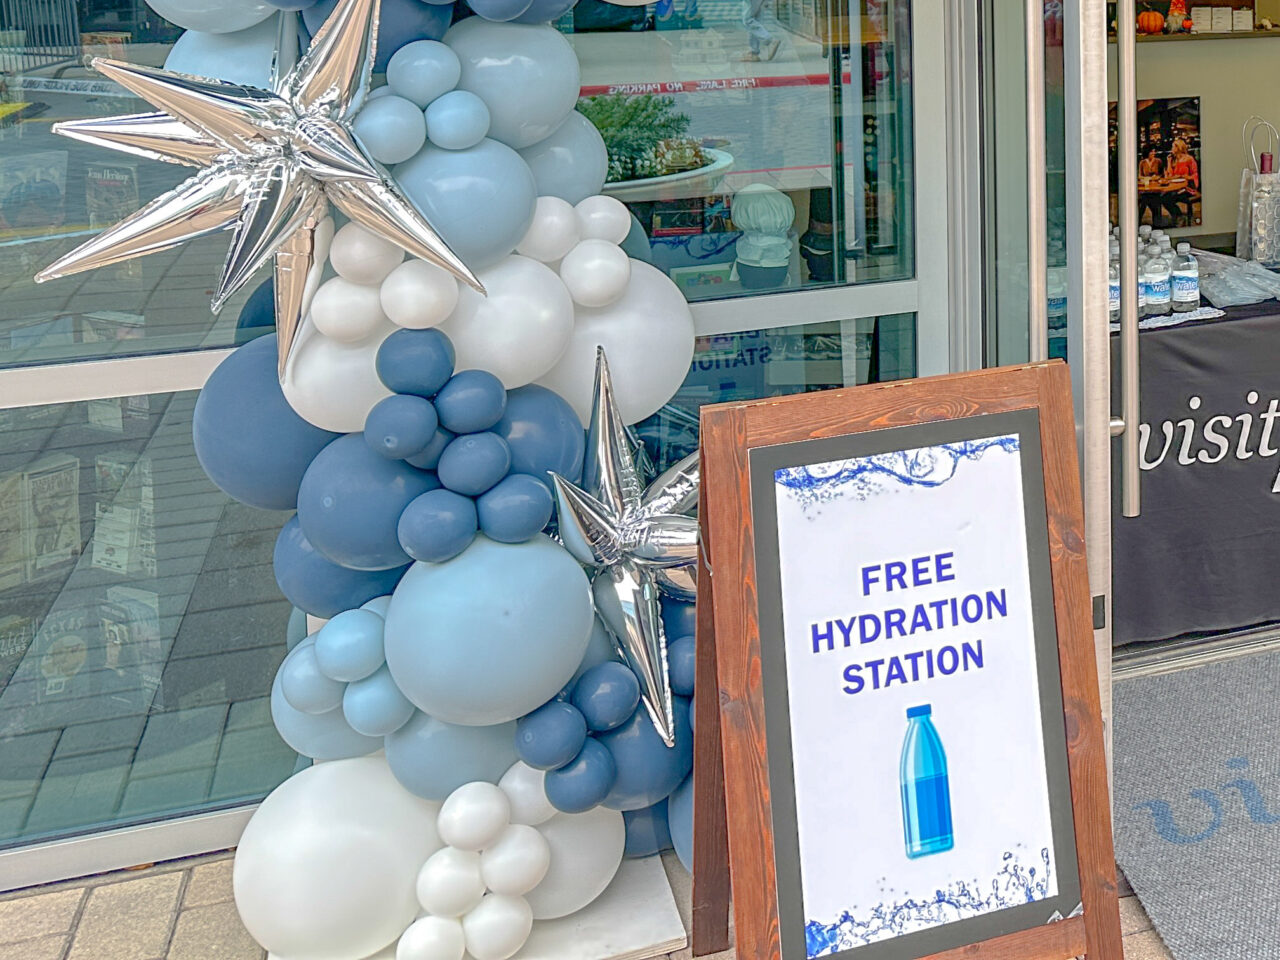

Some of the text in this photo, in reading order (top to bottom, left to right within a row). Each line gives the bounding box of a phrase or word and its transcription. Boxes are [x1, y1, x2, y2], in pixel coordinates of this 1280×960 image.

[861, 551, 956, 596] FREE
[811, 588, 1007, 654] HYDRATION
[842, 639, 984, 695] STATION
